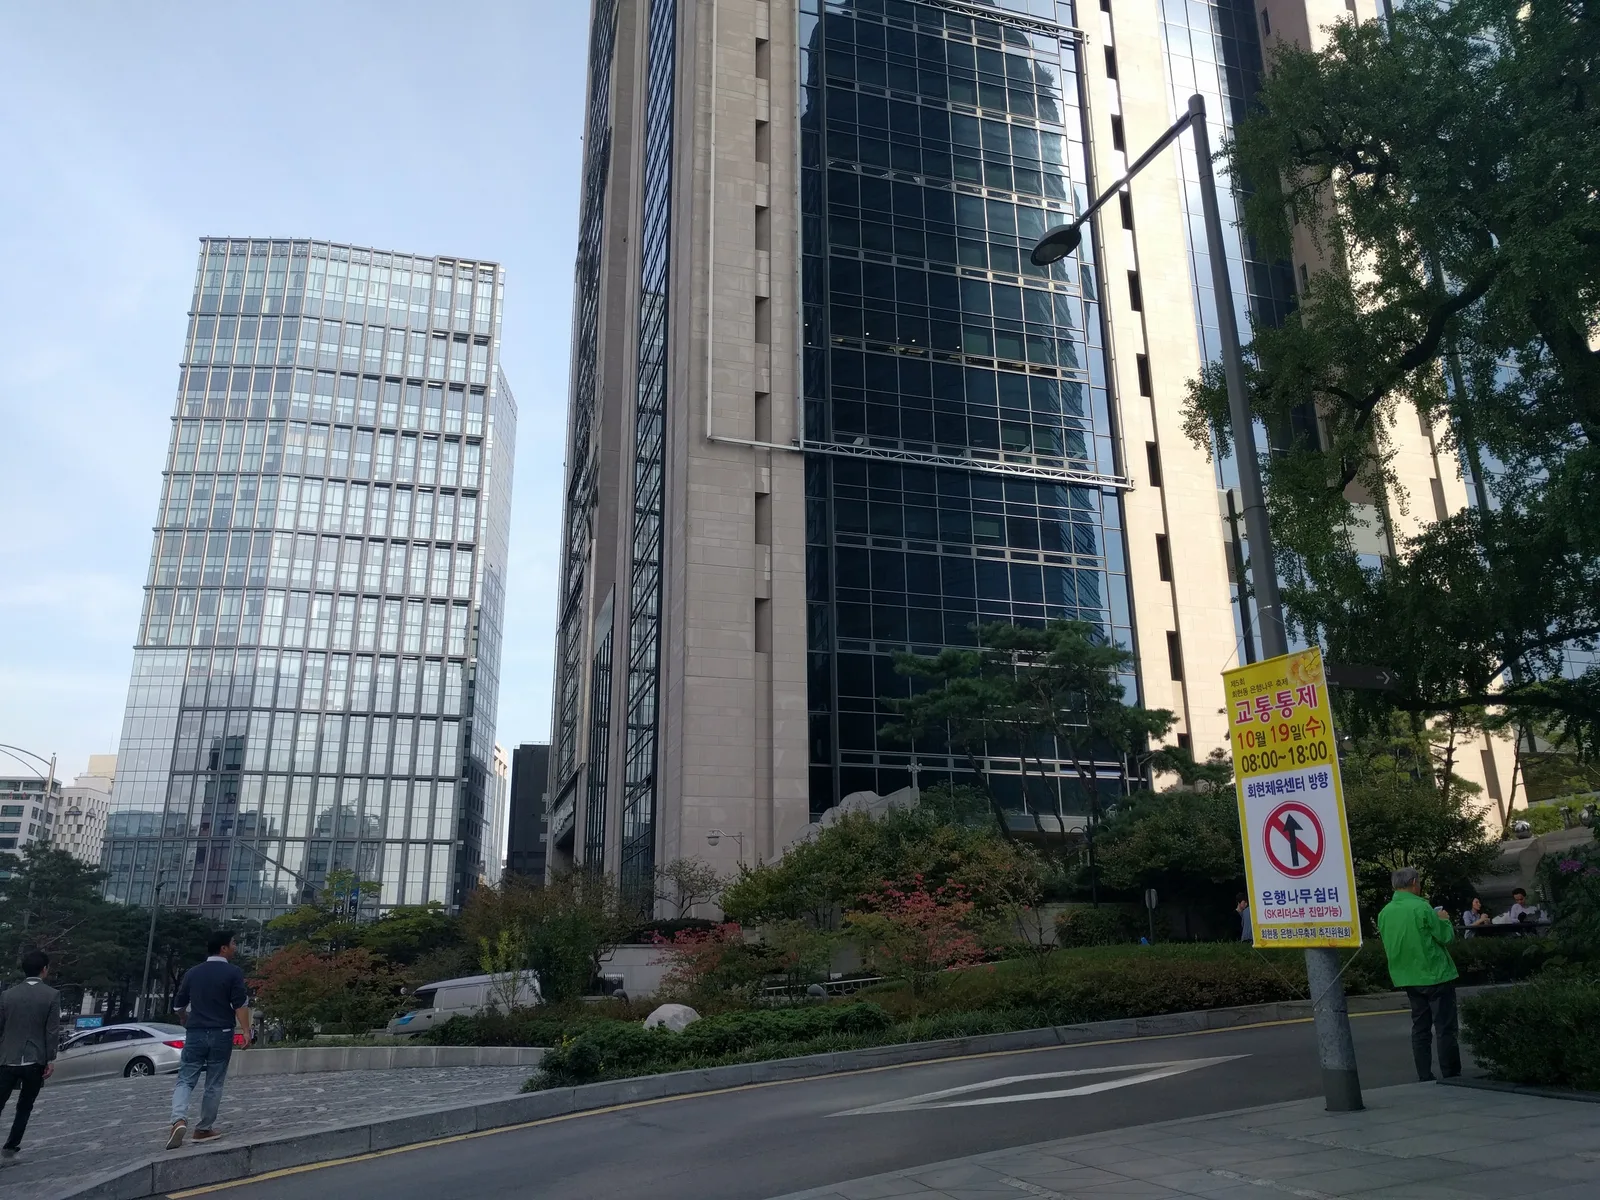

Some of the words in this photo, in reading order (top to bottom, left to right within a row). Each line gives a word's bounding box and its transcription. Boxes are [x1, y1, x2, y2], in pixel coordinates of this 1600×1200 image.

[1230, 677, 1245, 688] 제5회
[1232, 687, 1248, 698] 회현동
[1250, 681, 1273, 694] 은행나무
[1275, 677, 1289, 687] 축제
[1235, 684, 1318, 724] 교통통제
[1237, 730, 1267, 750] 10월
[1270, 715, 1326, 744] 19일(수)
[1241, 740, 1328, 773] 08:00~18:00
[1247, 776, 1306, 798] 회현체육센터
[1308, 771, 1329, 791] 방향
[1264, 907, 1306, 920] (SK리더스뷰
[1308, 905, 1342, 918] 진입가능)
[1261, 928, 1279, 939] 회현동
[1280, 928, 1316, 939] 은행나무축제
[1319, 926, 1351, 938] 추진위원회
